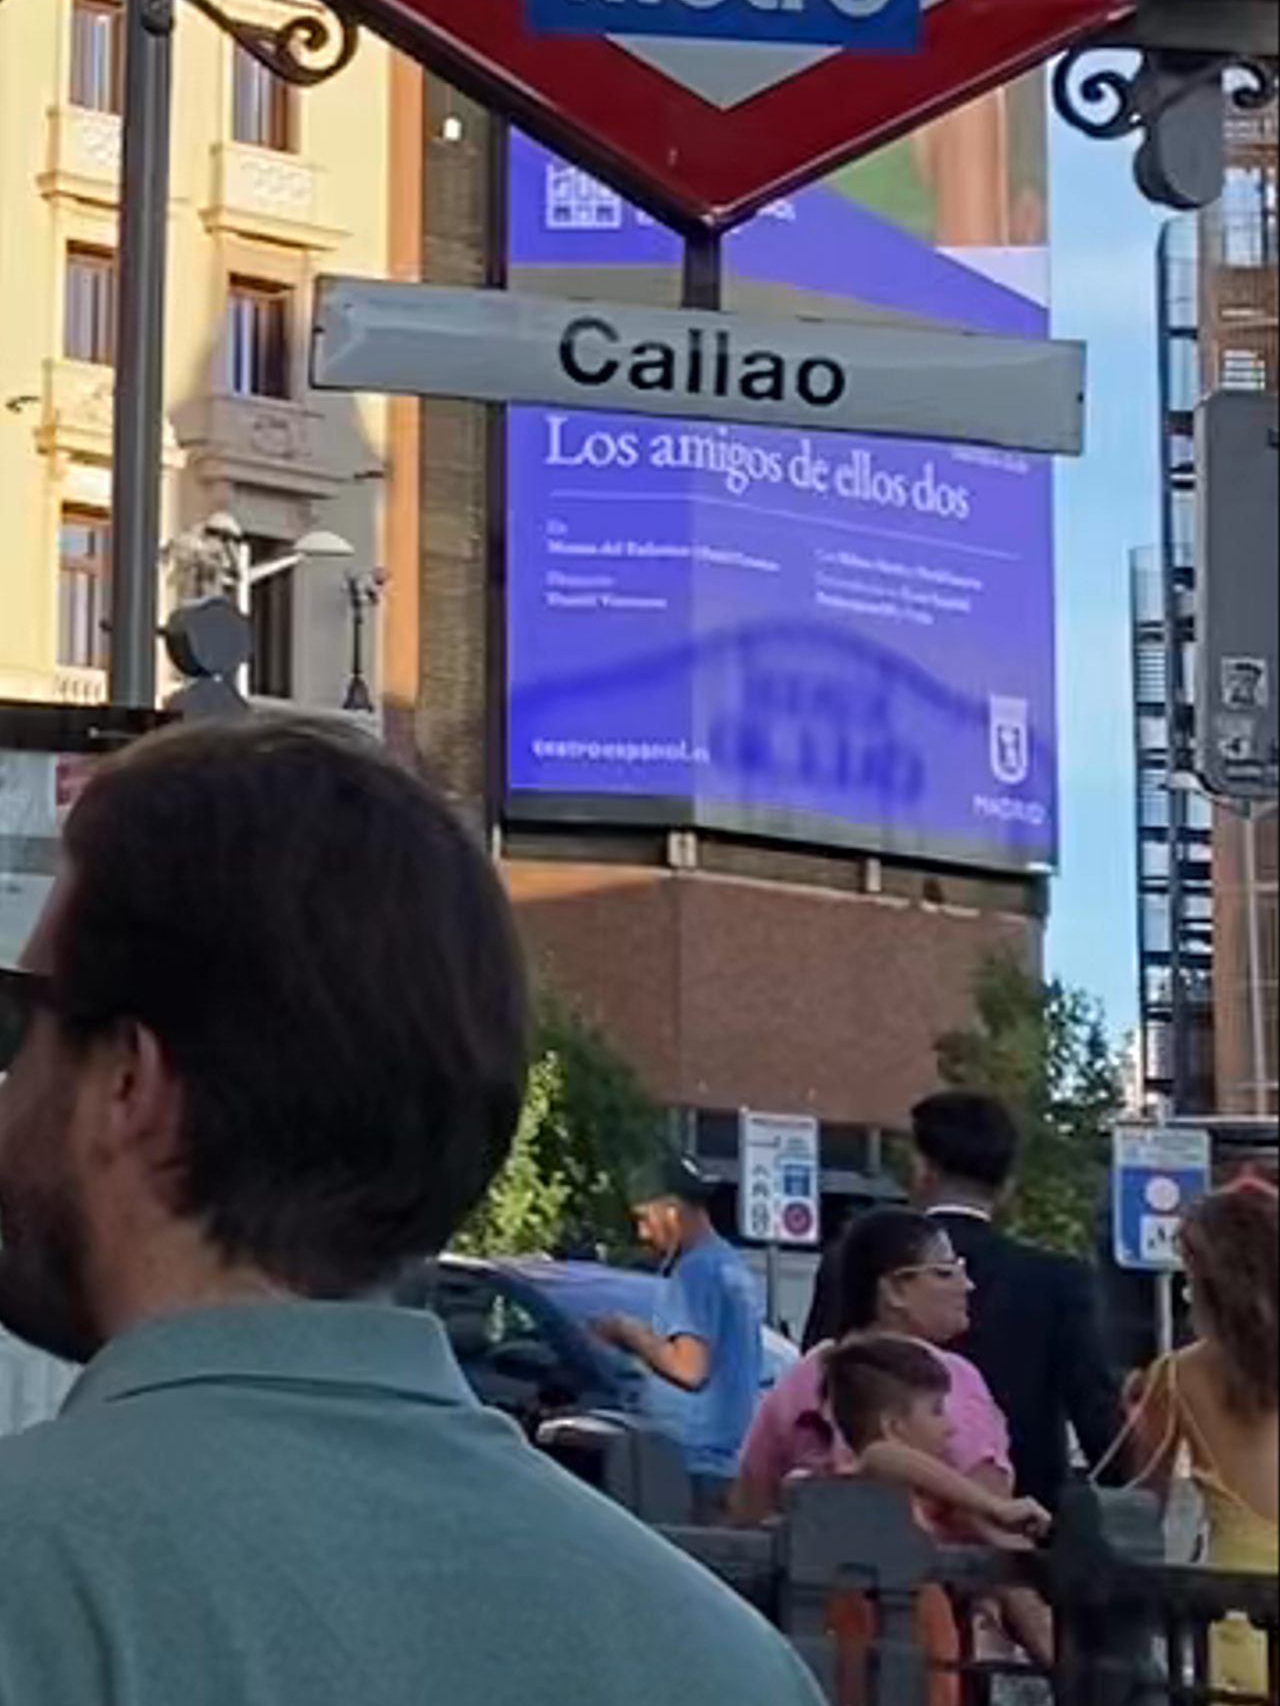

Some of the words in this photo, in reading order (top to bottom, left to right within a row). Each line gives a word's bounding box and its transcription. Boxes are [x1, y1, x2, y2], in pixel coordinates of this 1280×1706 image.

[559, 316, 848, 407] Callao
[546, 415, 638, 468] Los
[651, 427, 781, 494] amigos
[790, 440, 828, 492] de
[837, 452, 907, 508] ellos
[913, 466, 970, 520] dos
